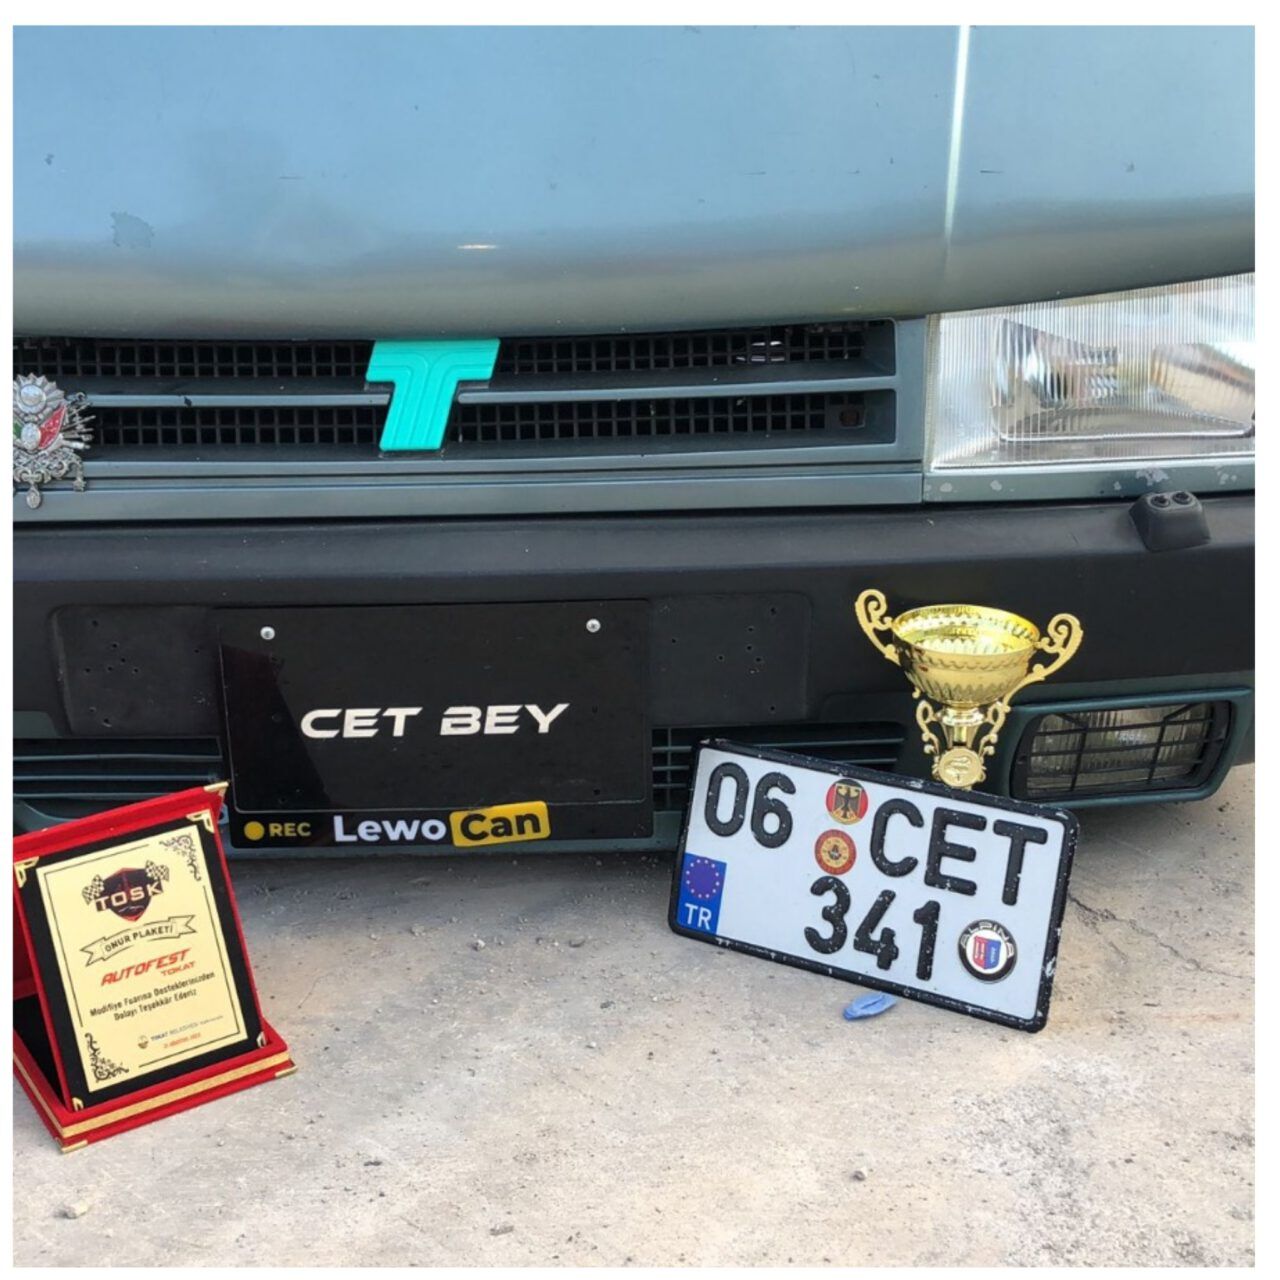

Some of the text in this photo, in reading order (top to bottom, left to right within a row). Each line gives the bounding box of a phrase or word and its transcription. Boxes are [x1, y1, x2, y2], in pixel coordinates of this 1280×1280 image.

[301, 703, 570, 739] CET BEY
[269, 822, 311, 837] REC
[333, 812, 541, 842] Lewo Can
[704, 762, 1049, 906] 06 CET
[95, 882, 163, 911] TOSK
[685, 903, 712, 931] TR
[804, 876, 940, 980] 341
[104, 925, 174, 952] ONUR PLAKETİ
[960, 921, 1016, 959] ALPINA
[101, 948, 192, 987] AUTOFEST
[161, 961, 196, 977] TOKAT
[90, 1001, 122, 1017] Modifiye
